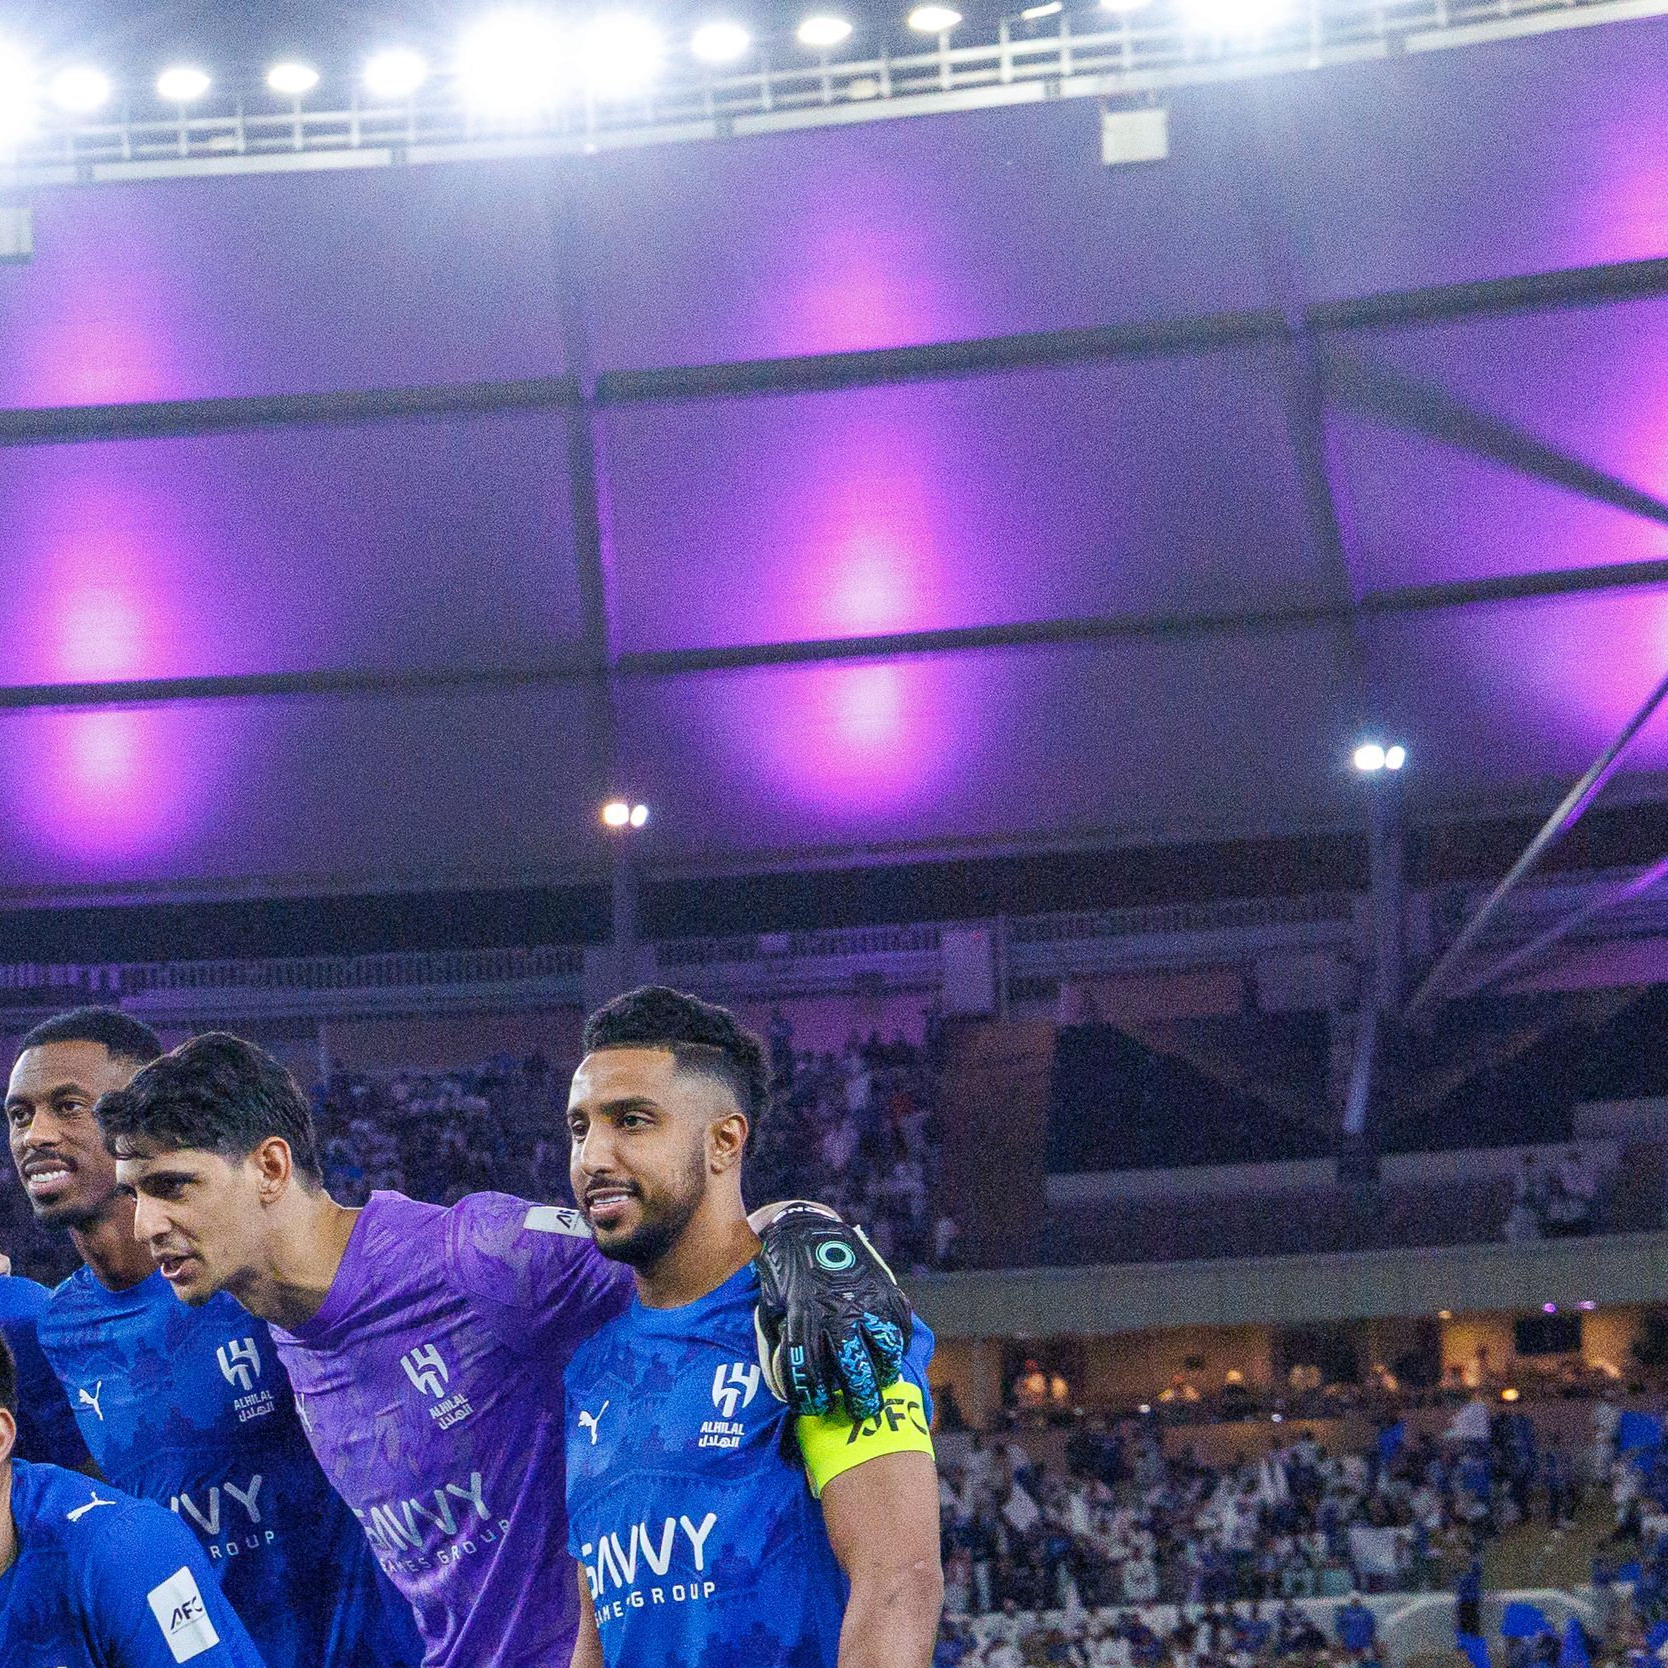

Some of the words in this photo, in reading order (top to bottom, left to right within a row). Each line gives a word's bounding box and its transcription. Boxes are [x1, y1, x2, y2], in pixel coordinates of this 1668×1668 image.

[555, 1208, 577, 1230] AF
[697, 1434, 741, 1449] الهلال
[700, 1420, 746, 1436] ALHILAL
[209, 1530, 276, 1559] ROUP
[581, 1512, 718, 1601] SAVVY
[630, 1580, 716, 1609] GROUP
[170, 1594, 203, 1631] AFC
